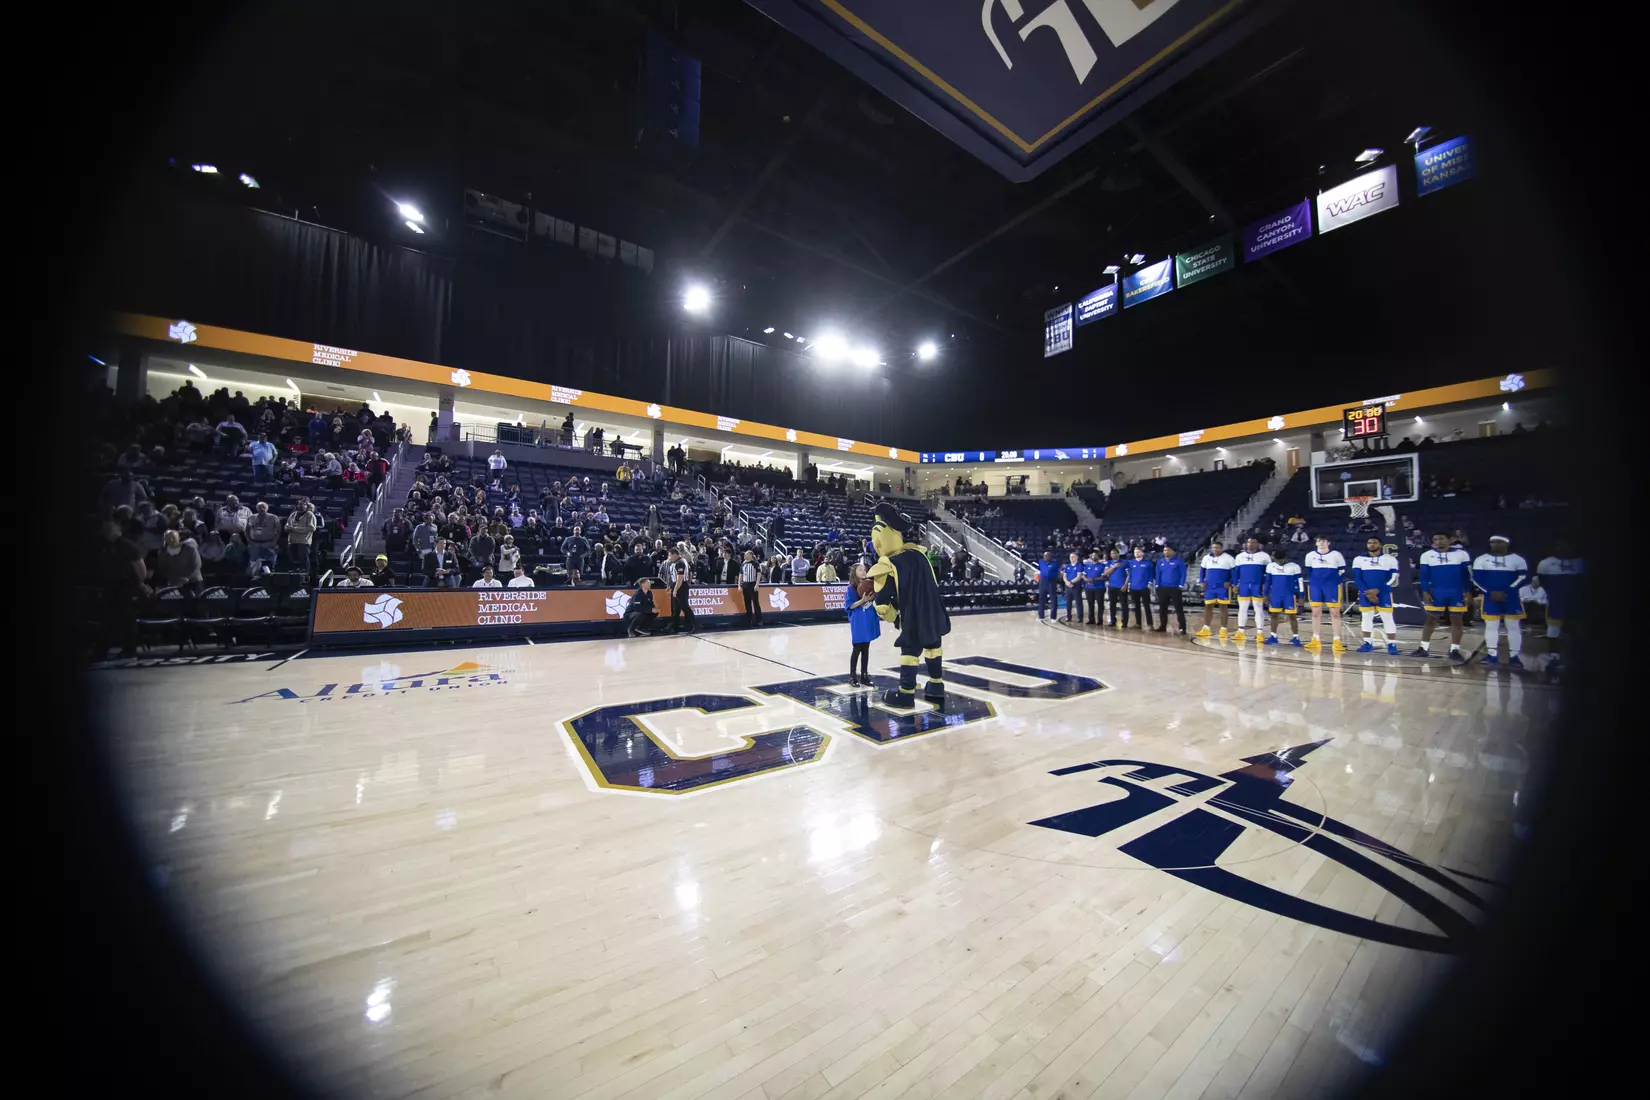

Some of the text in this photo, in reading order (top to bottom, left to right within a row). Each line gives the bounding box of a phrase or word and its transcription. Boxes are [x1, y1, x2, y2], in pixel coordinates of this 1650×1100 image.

[1421, 165, 1438, 176] OF
[1326, 182, 1385, 217] WAC
[1259, 215, 1291, 233] GRAND
[1250, 226, 1303, 252] UNIVERSITY
[1256, 222, 1295, 242] CANYON
[1185, 245, 1221, 264] CHICAGO
[1192, 254, 1215, 268] STATE
[1183, 257, 1228, 279] UNIVERSITY
[1079, 303, 1114, 320] UNIVERSITY
[313, 343, 358, 357] RIVERSIDE
[313, 350, 352, 362] MEDICAL
[312, 357, 341, 367] CLINIC
[1353, 417, 1378, 435] 30
[944, 452, 964, 462] CBU
[478, 591, 547, 601] RIVERSIDE
[688, 587, 728, 596] IVERSIDE
[822, 585, 848, 593] RIVERS
[823, 593, 846, 601] MEDIC
[478, 602, 538, 613] MEDICAL
[477, 614, 522, 625] CLINIC
[555, 654, 1117, 799] CBU
